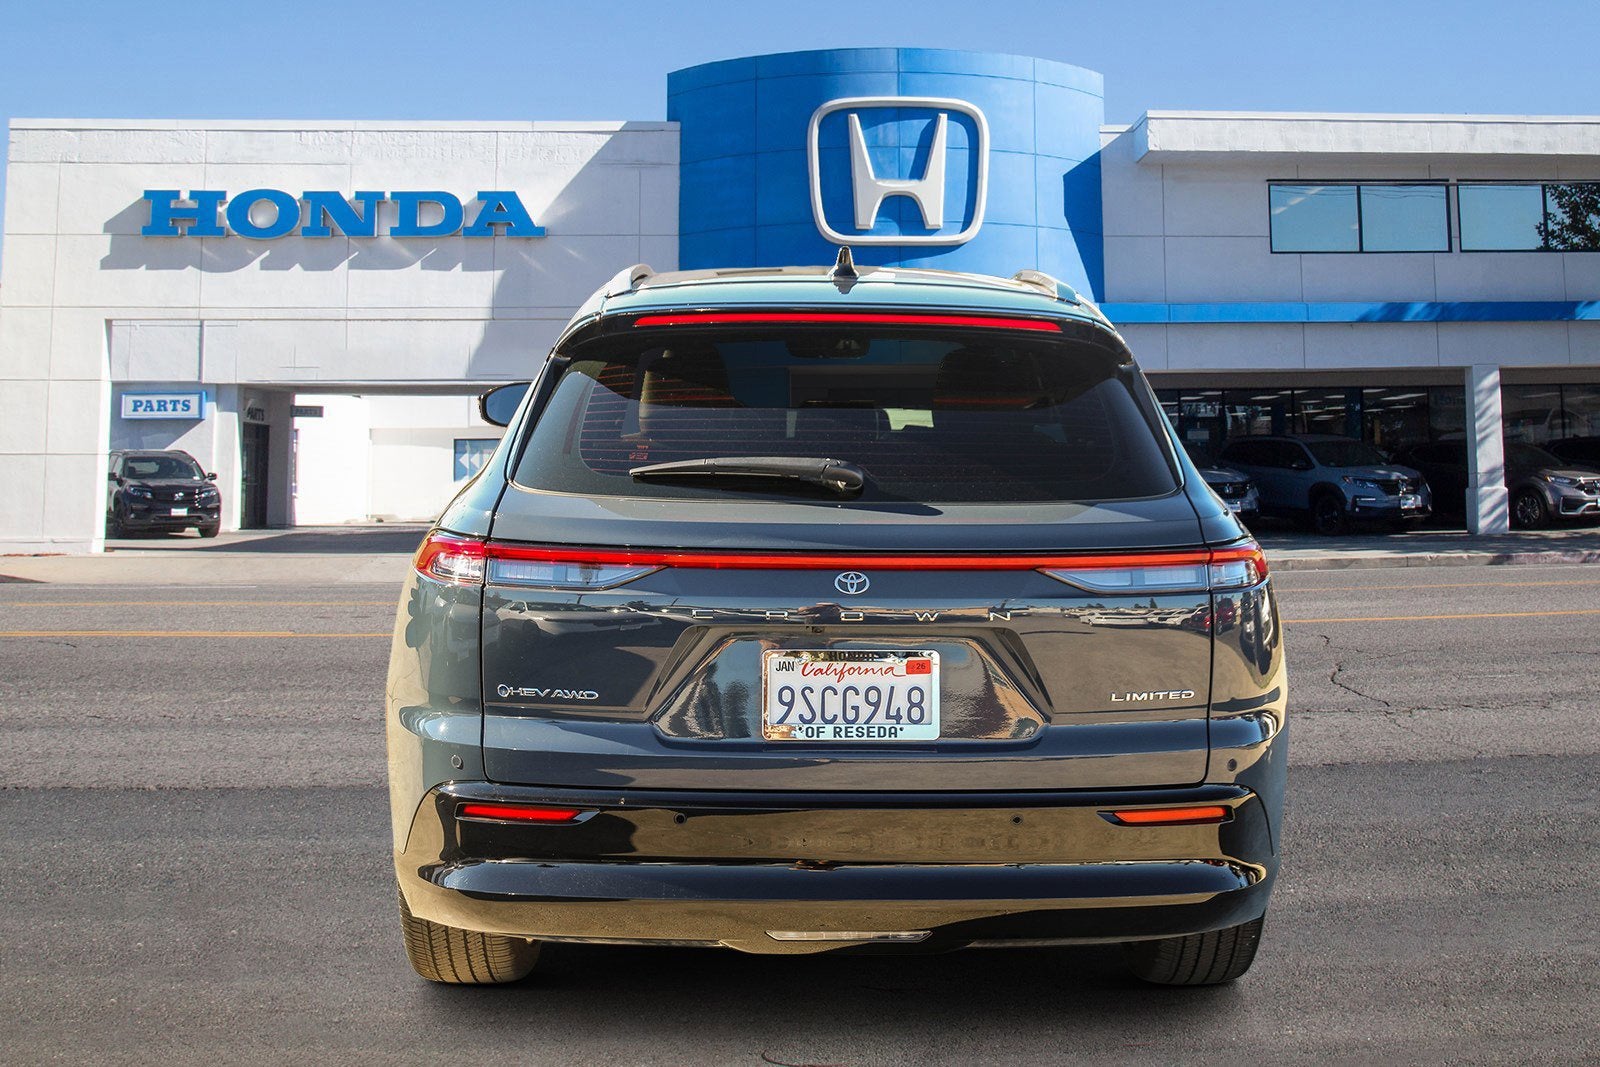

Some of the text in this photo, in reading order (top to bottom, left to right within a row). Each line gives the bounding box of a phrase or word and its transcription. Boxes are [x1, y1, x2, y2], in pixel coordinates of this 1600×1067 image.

[142, 189, 548, 240] HONDA
[132, 400, 191, 412] PARTS
[692, 608, 1012, 622] CROWN
[775, 661, 795, 672] JAN
[801, 662, 906, 683] California
[510, 686, 599, 700] HEV AWD
[1110, 690, 1195, 702] LIMITED
[776, 685, 925, 725] 9SCG948
[805, 726, 898, 739] OF RESEDA
